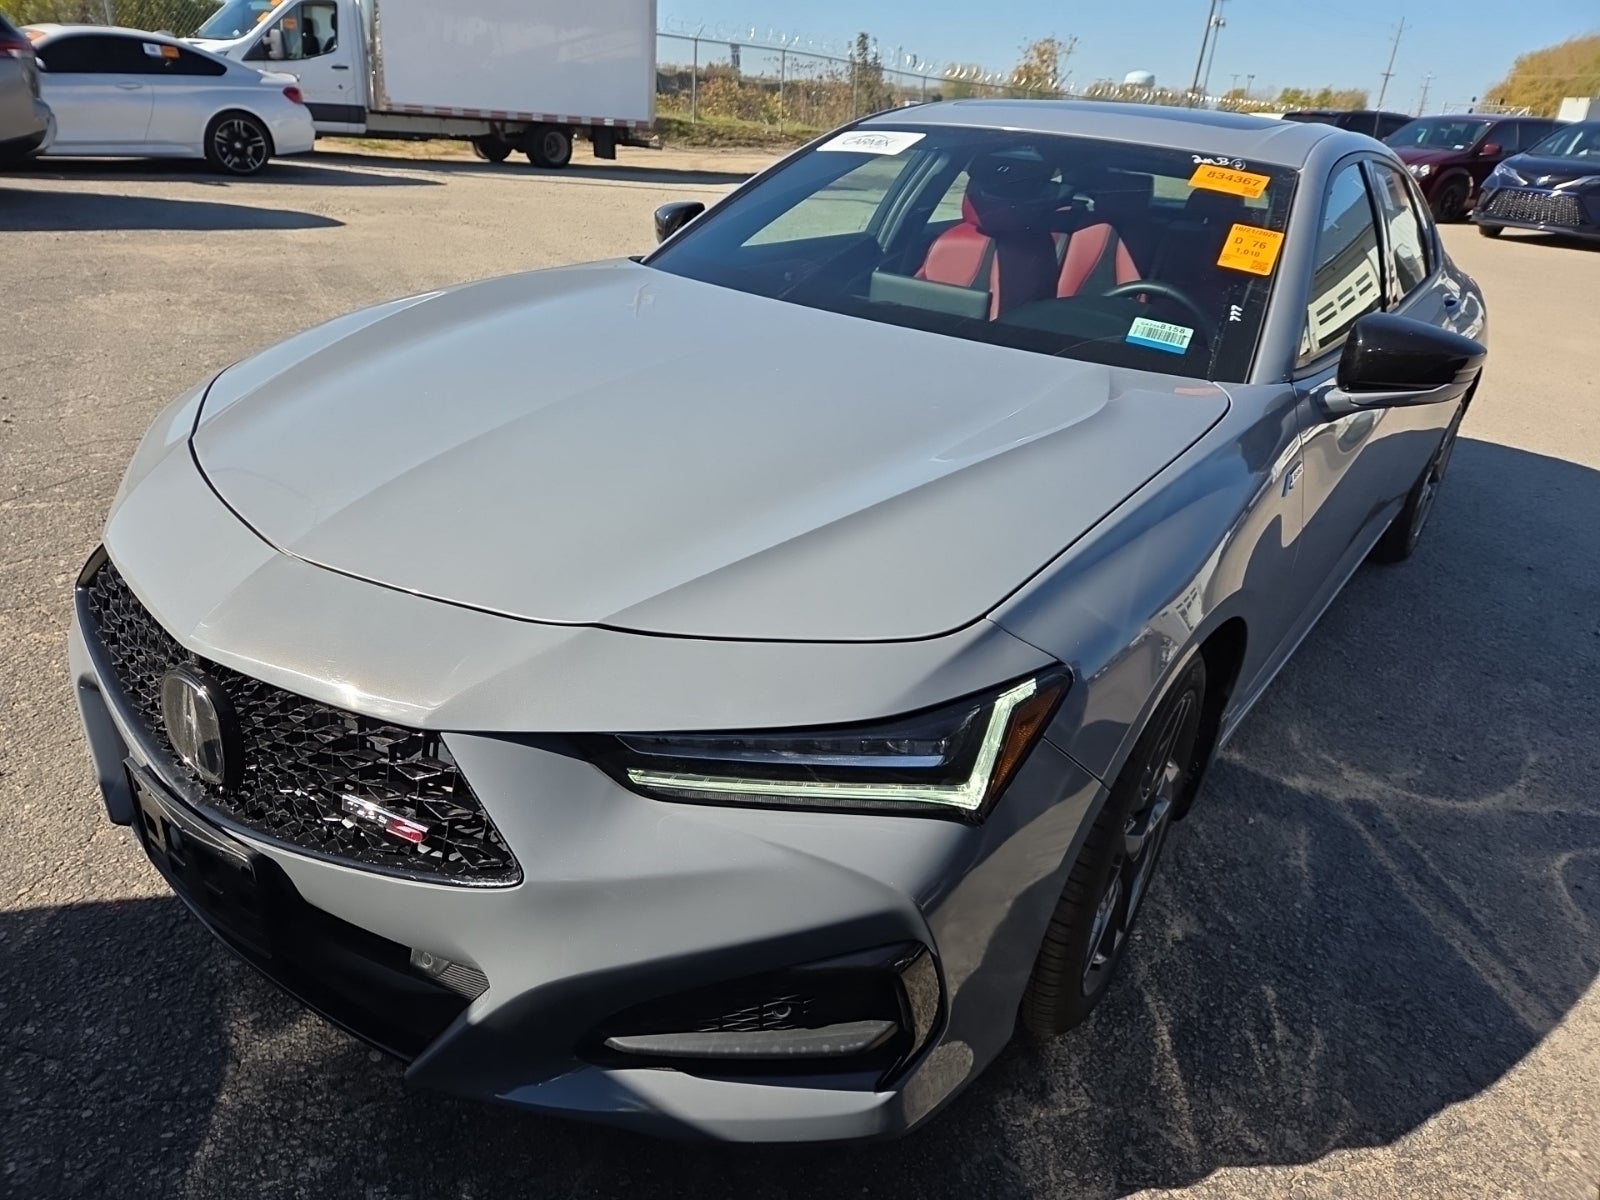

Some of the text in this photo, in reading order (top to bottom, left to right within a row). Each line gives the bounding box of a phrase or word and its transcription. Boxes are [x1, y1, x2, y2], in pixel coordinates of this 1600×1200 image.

[1206, 170, 1262, 187] 834367
[1234, 236, 1268, 250] D 76
